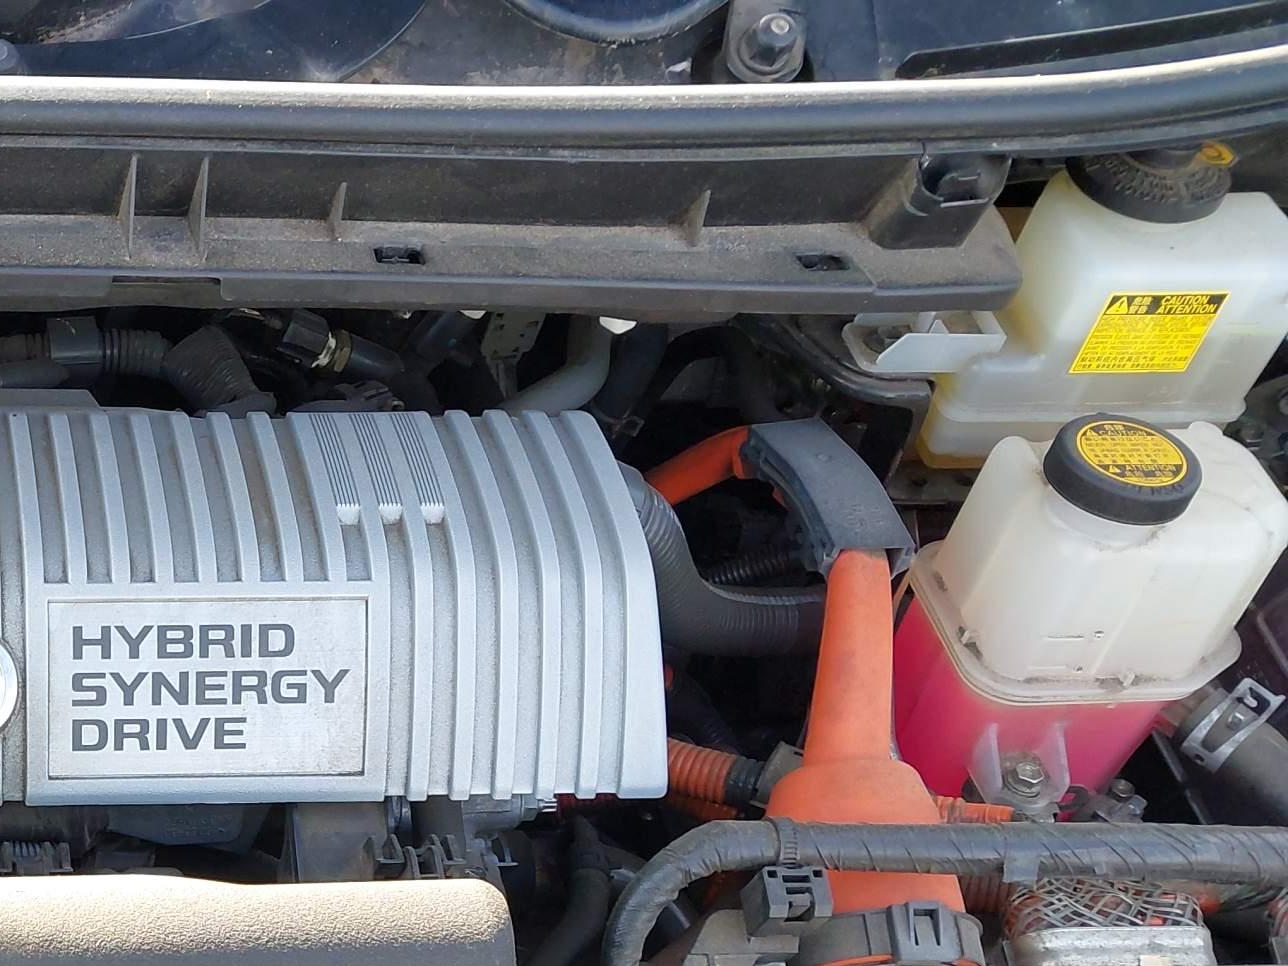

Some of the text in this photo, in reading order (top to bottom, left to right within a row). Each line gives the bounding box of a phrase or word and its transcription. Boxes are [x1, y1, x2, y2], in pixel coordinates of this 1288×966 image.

[1156, 304, 1218, 314] ATTENTION
[1162, 296, 1211, 305] CAUTION
[72, 623, 295, 660] HYBRID
[71, 669, 351, 707] SYNERGY
[71, 717, 247, 751] DRIVE
